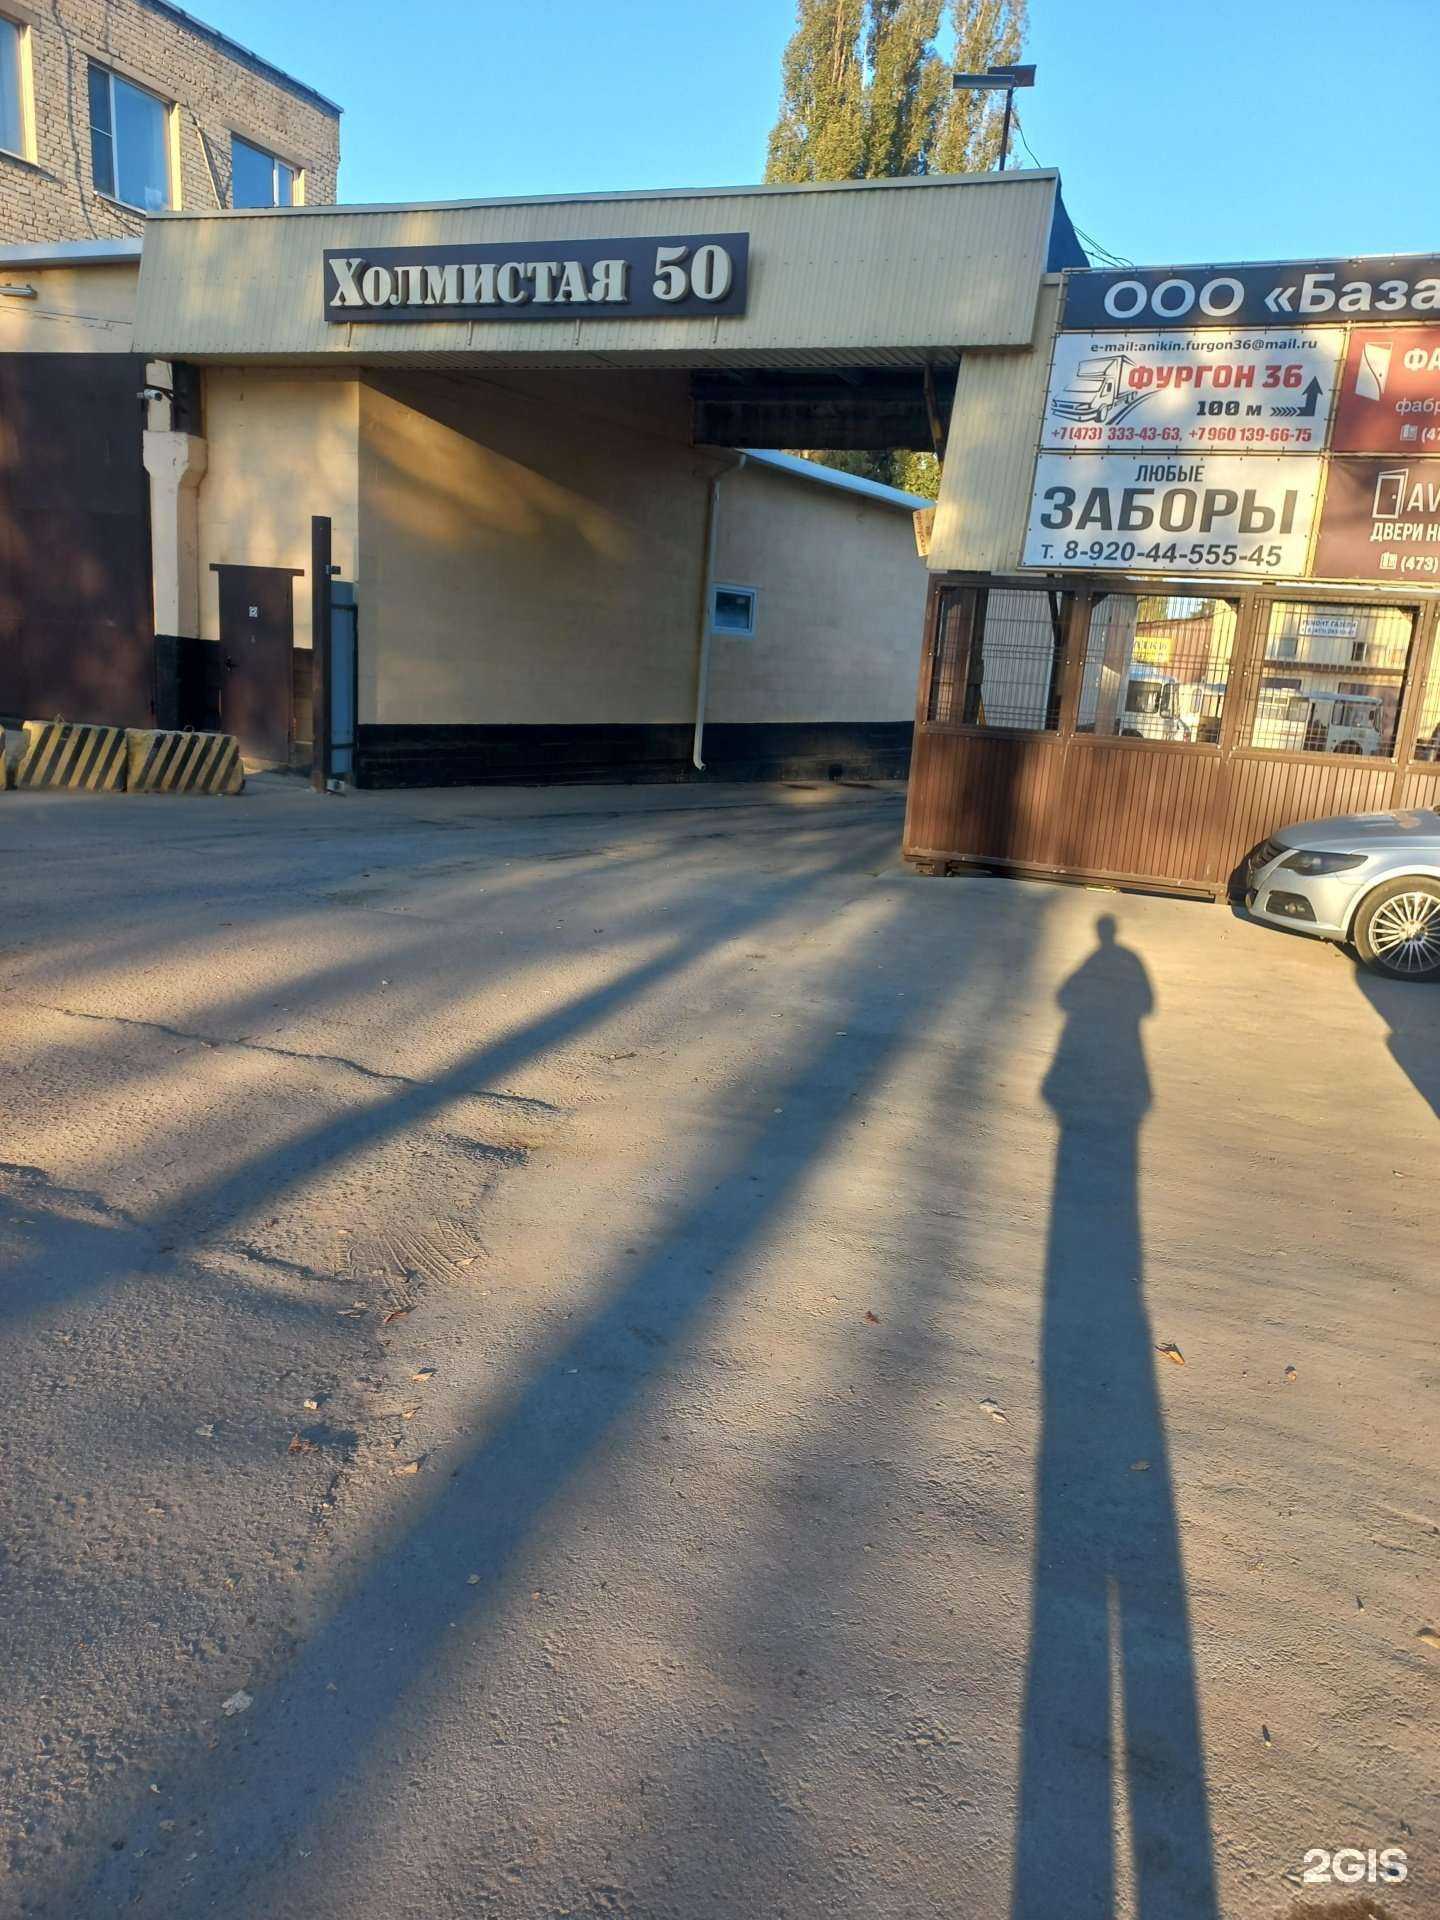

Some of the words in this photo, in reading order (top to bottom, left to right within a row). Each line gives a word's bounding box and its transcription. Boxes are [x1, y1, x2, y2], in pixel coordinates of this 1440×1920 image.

[652, 245, 733, 300] 50
[1104, 277, 1245, 318] ООО
[1090, 339, 1318, 353] e-mail:anikin.furgon36@mail.ru
[1127, 364, 1255, 390] ФУРГОН
[1261, 364, 1303, 388] 36
[1196, 400, 1239, 416] 100
[1246, 404, 1262, 416] м
[1108, 427, 1182, 442] 333-43-63,
[1239, 430, 1312, 443] 139-66-75
[1134, 465, 1205, 482] ЛЮБЫЕ
[1040, 486, 1298, 534] ЗАБОРЫ
[1369, 522, 1424, 542] ДВЕРИ
[1064, 540, 1282, 567] 8-920-44-555-45
[1400, 556, 1439, 573] (473)
